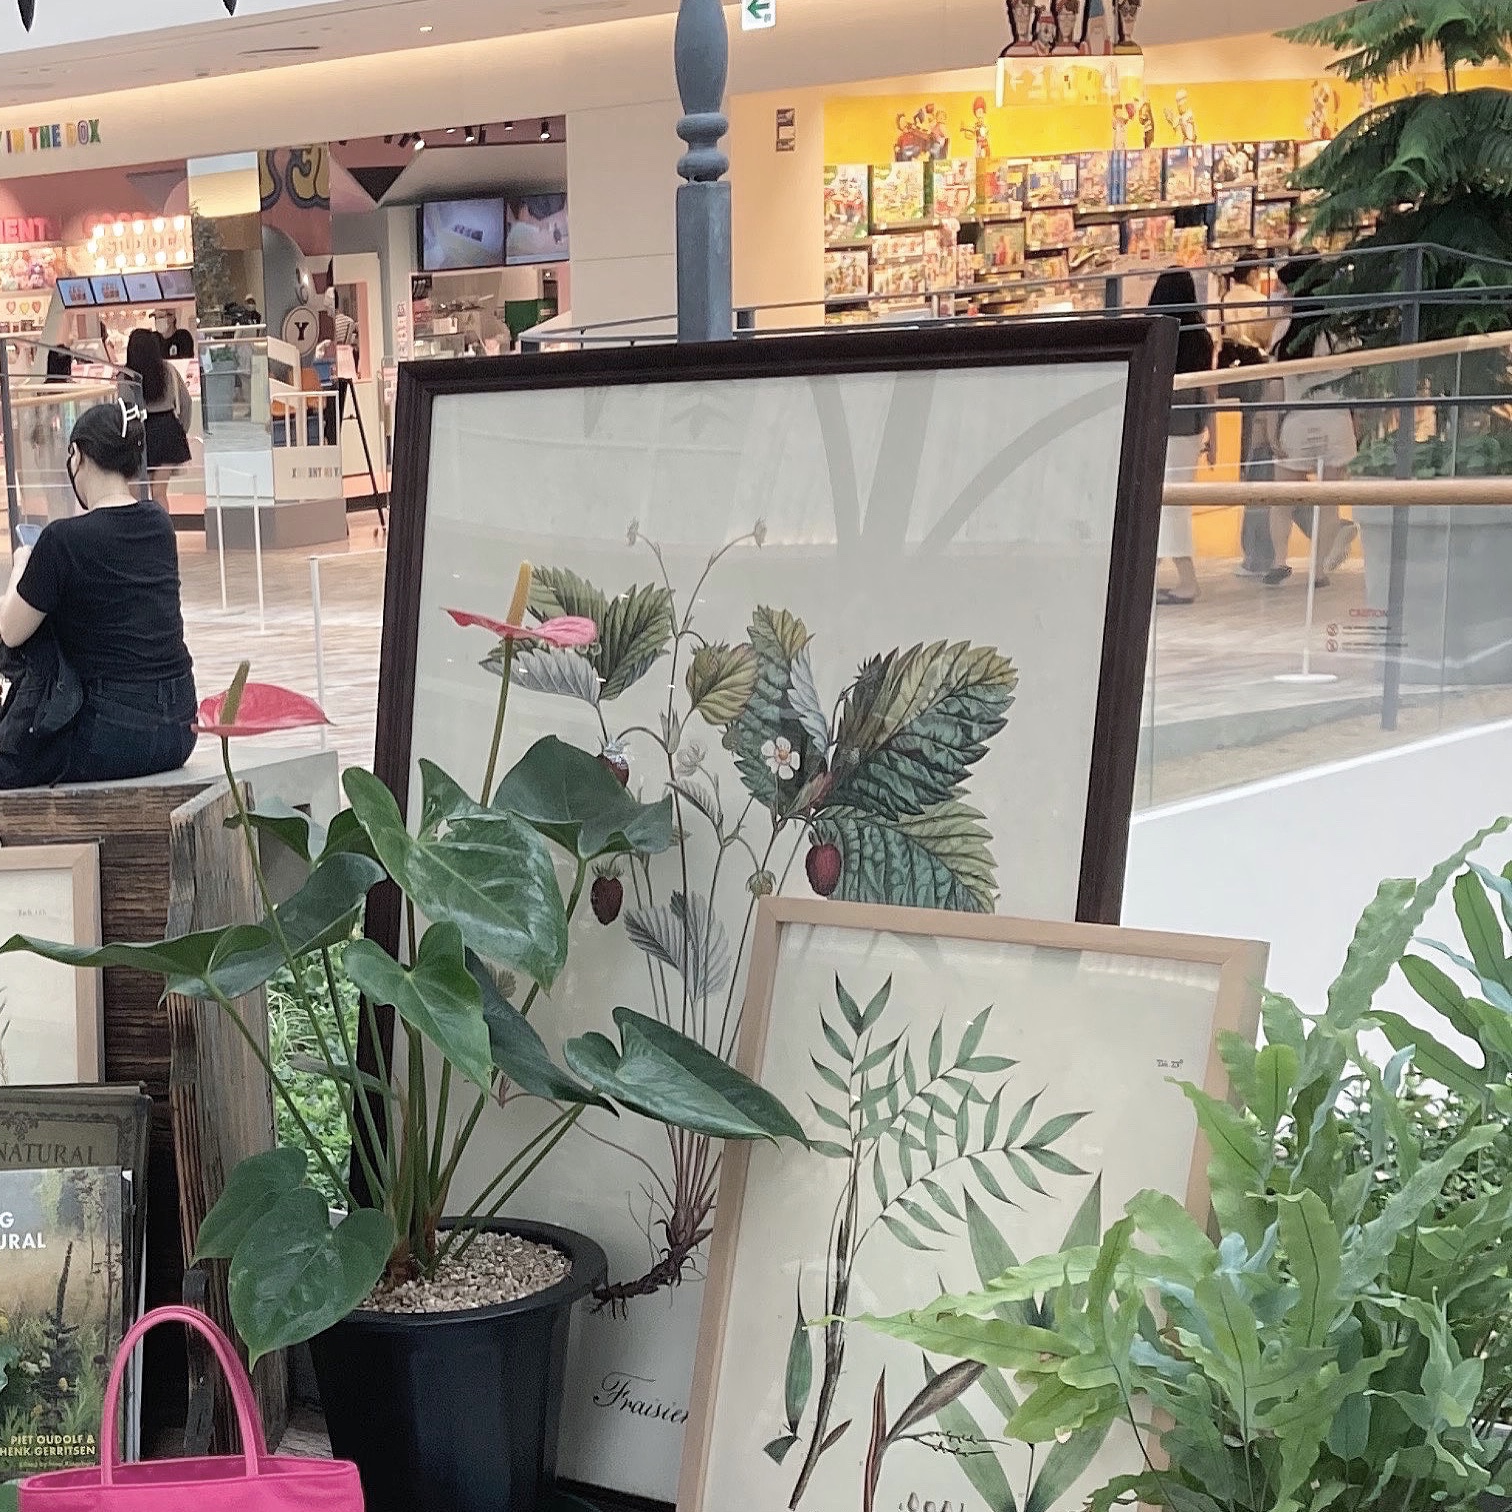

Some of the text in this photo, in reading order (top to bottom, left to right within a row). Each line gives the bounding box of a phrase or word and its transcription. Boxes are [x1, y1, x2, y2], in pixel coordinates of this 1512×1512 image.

[5, 127, 26, 154] IN
[28, 123, 62, 150] THE
[294, 321, 310, 341] Y
[10, 1434, 95, 1445] PIET OUDOLF &
[0, 1445, 96, 1457] HENK GERRITSEN
